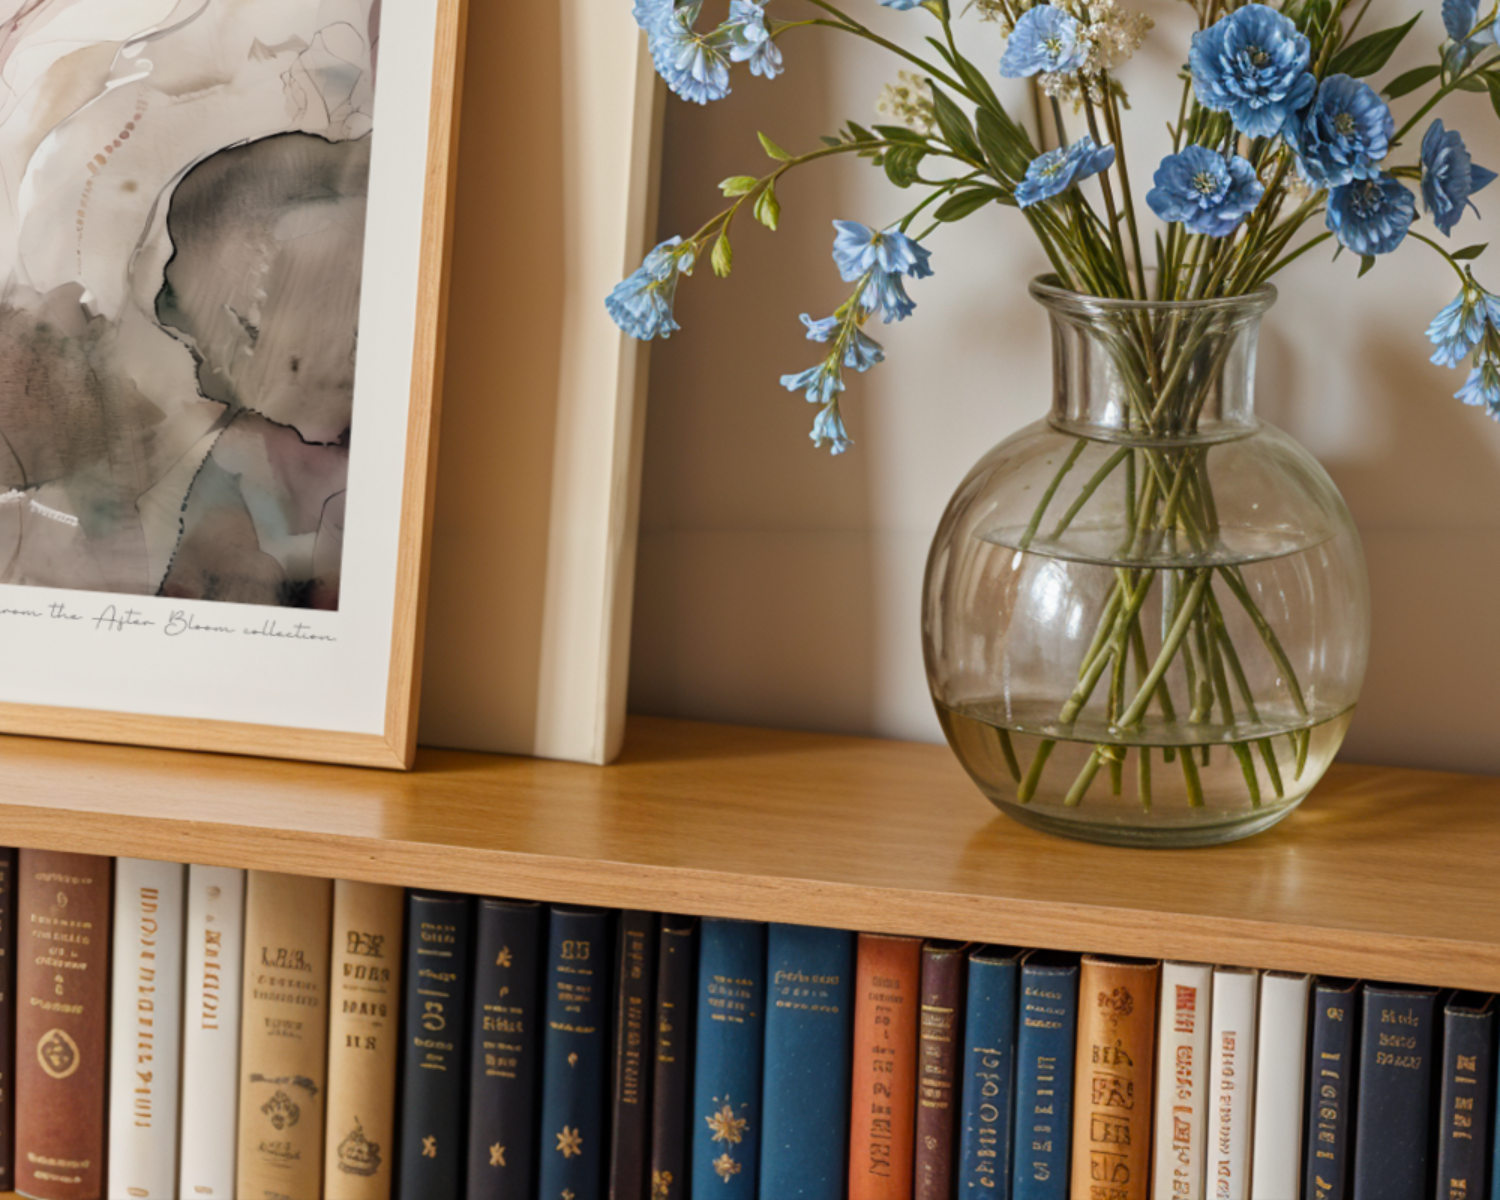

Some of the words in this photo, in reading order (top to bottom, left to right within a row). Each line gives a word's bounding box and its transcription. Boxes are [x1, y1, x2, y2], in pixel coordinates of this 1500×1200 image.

[48, 601, 84, 620] the
[90, 604, 156, 631] After
[164, 609, 236, 636] Bloom
[243, 619, 337, 642] collection
